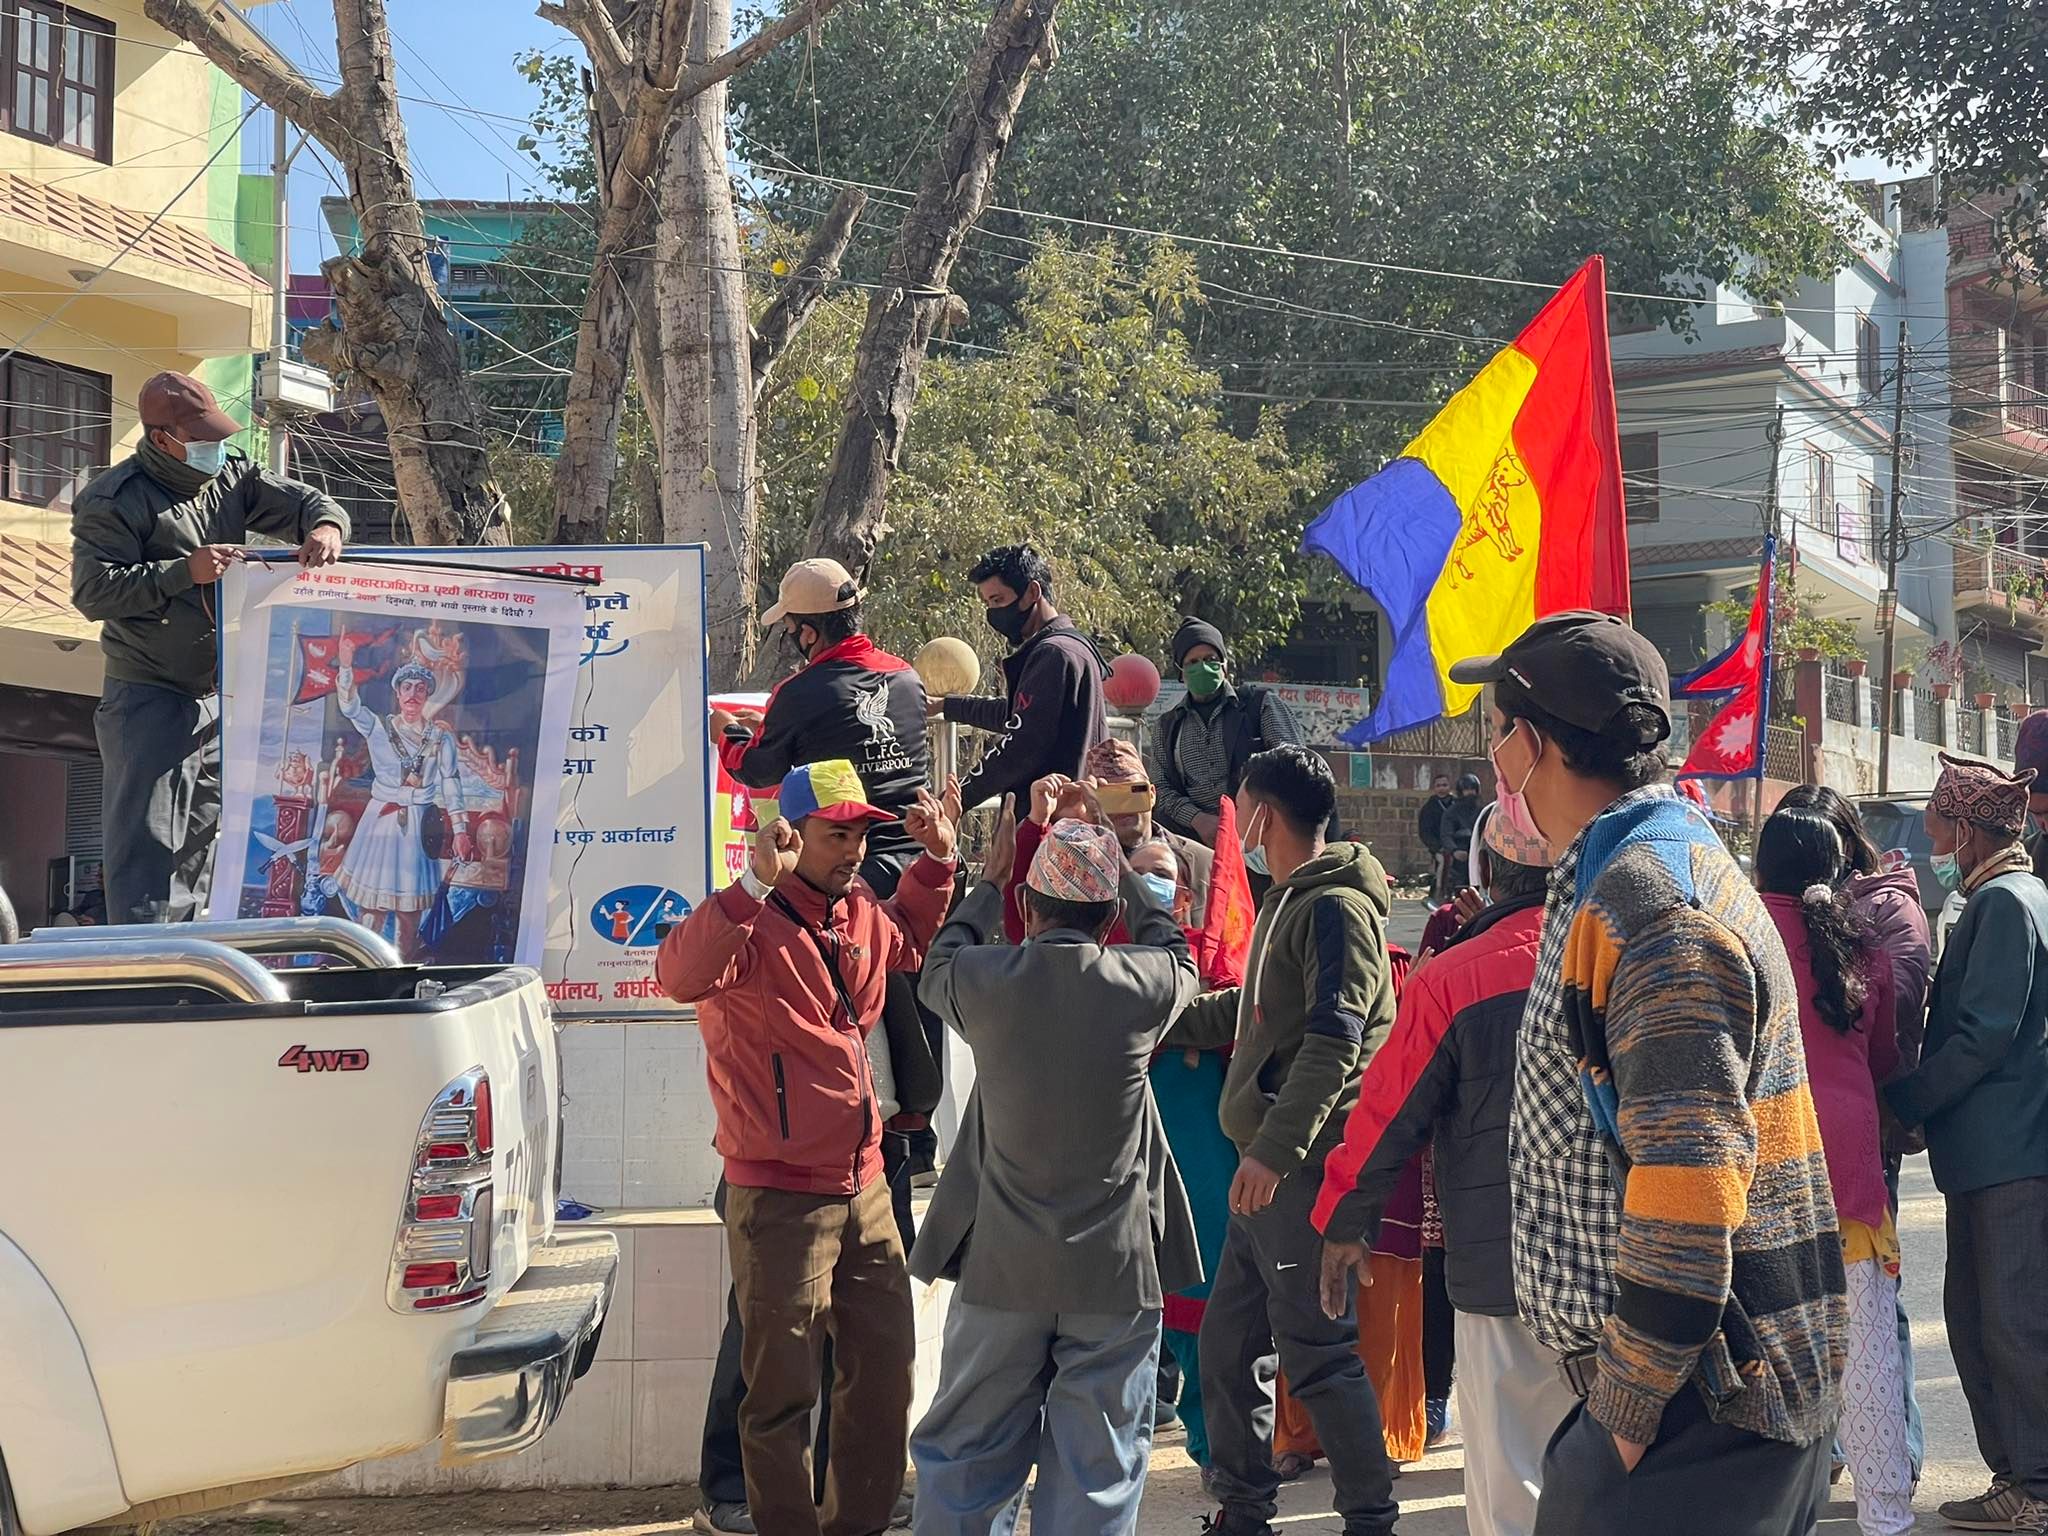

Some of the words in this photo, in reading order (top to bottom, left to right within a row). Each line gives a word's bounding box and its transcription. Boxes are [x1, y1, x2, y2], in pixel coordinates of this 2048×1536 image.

[464, 587, 509, 601] नारायण
[513, 592, 536, 605] शाह
[855, 757, 913, 774] LIVERPOOL
[565, 830, 597, 846] एक
[601, 825, 678, 843] अर्कालाई
[278, 1045, 369, 1072] 4WD
